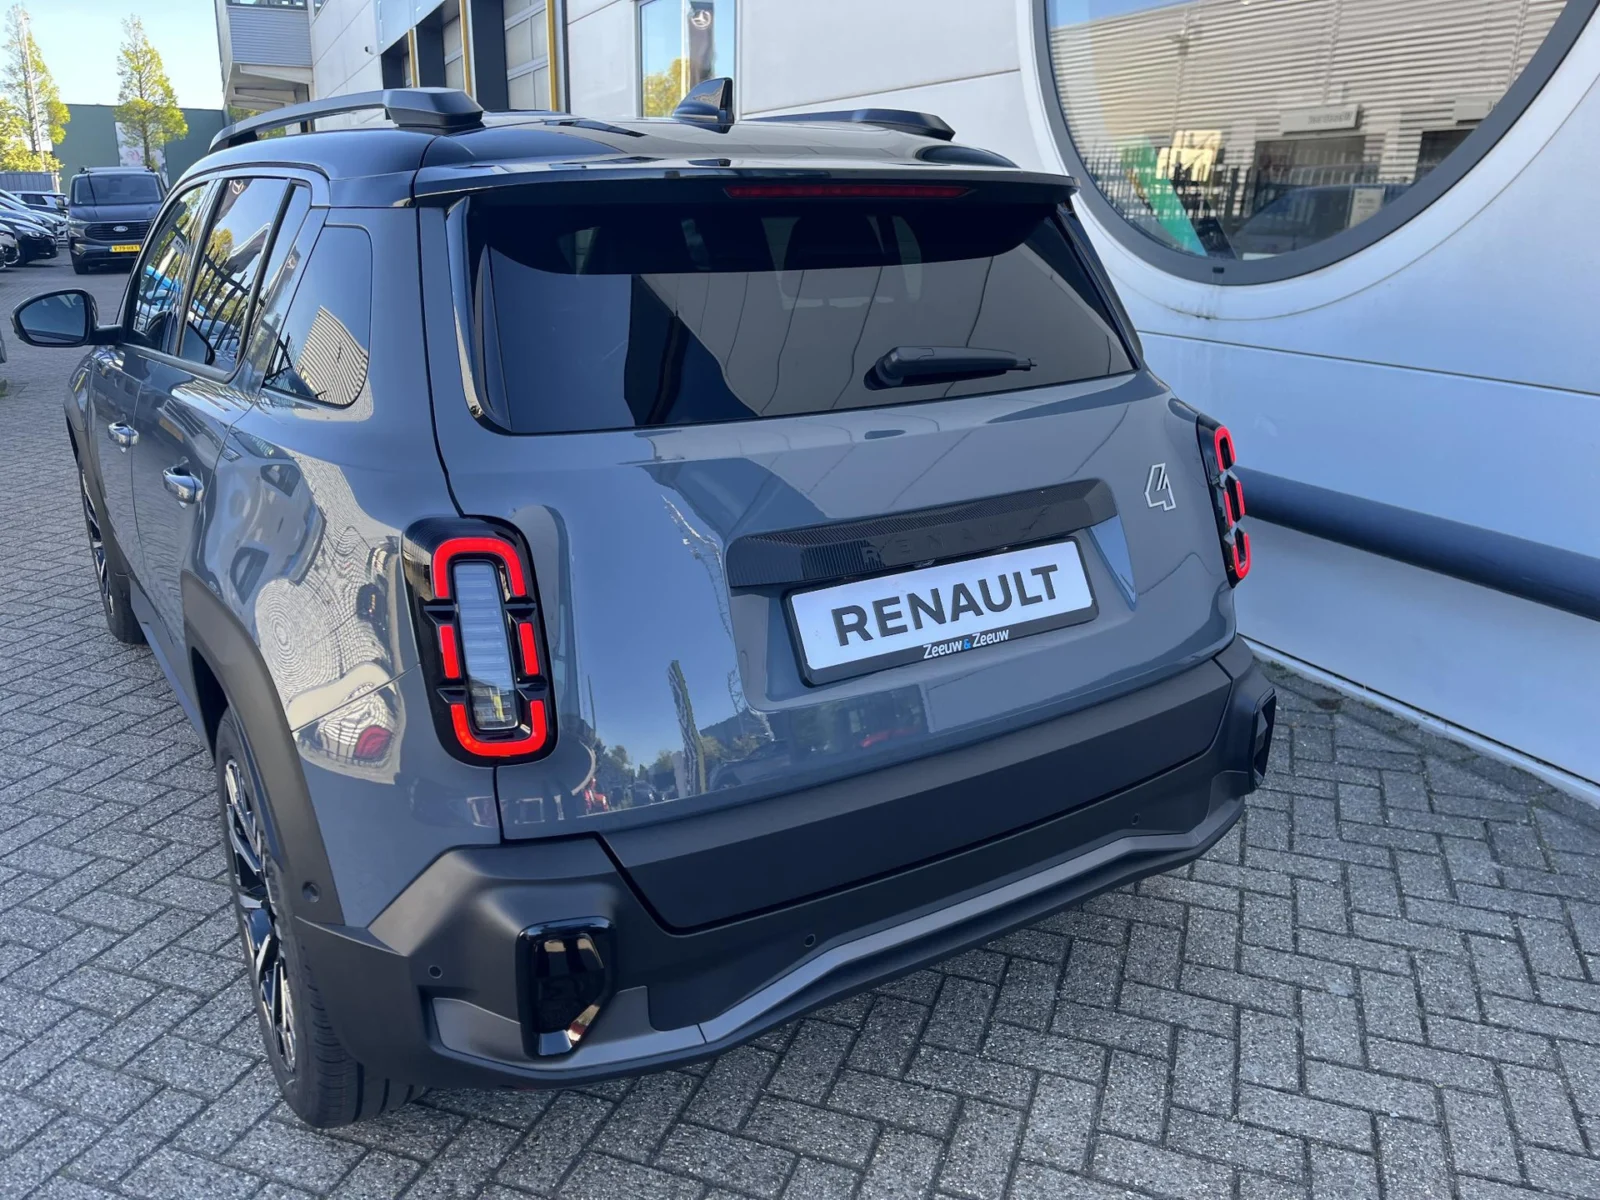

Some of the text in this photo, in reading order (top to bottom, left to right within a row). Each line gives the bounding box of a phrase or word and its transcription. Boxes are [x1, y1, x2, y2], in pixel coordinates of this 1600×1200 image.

[1144, 462, 1176, 511] 4
[831, 563, 1058, 647] RENAULT
[923, 640, 962, 659] Zeeuw
[972, 629, 1009, 648] Zeeuw
